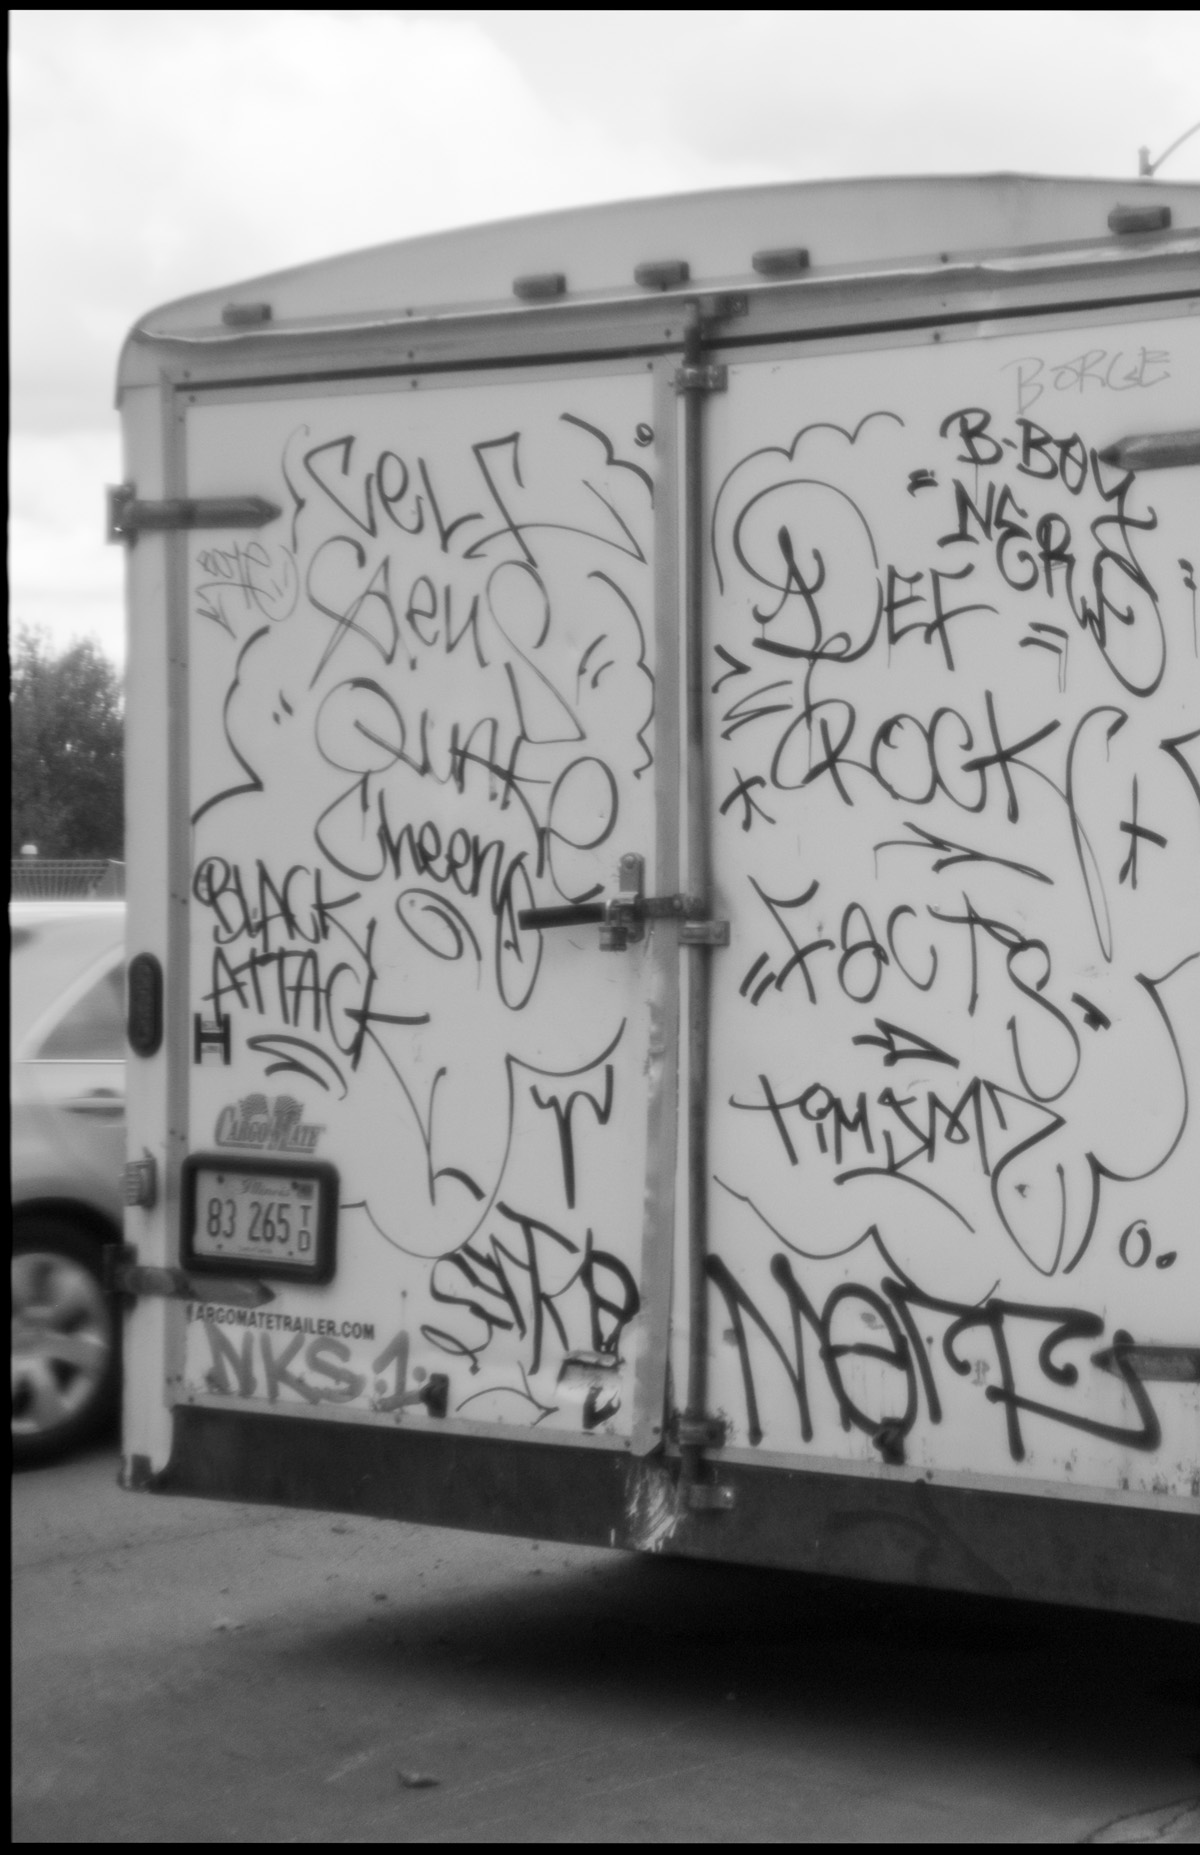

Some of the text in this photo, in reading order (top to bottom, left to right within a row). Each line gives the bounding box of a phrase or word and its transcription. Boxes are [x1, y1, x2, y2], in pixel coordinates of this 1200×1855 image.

[193, 856, 363, 952] BLACK
[202, 917, 431, 1073] ATTACK
[207, 1197, 238, 1239] 83
[248, 1201, 292, 1244] 265
